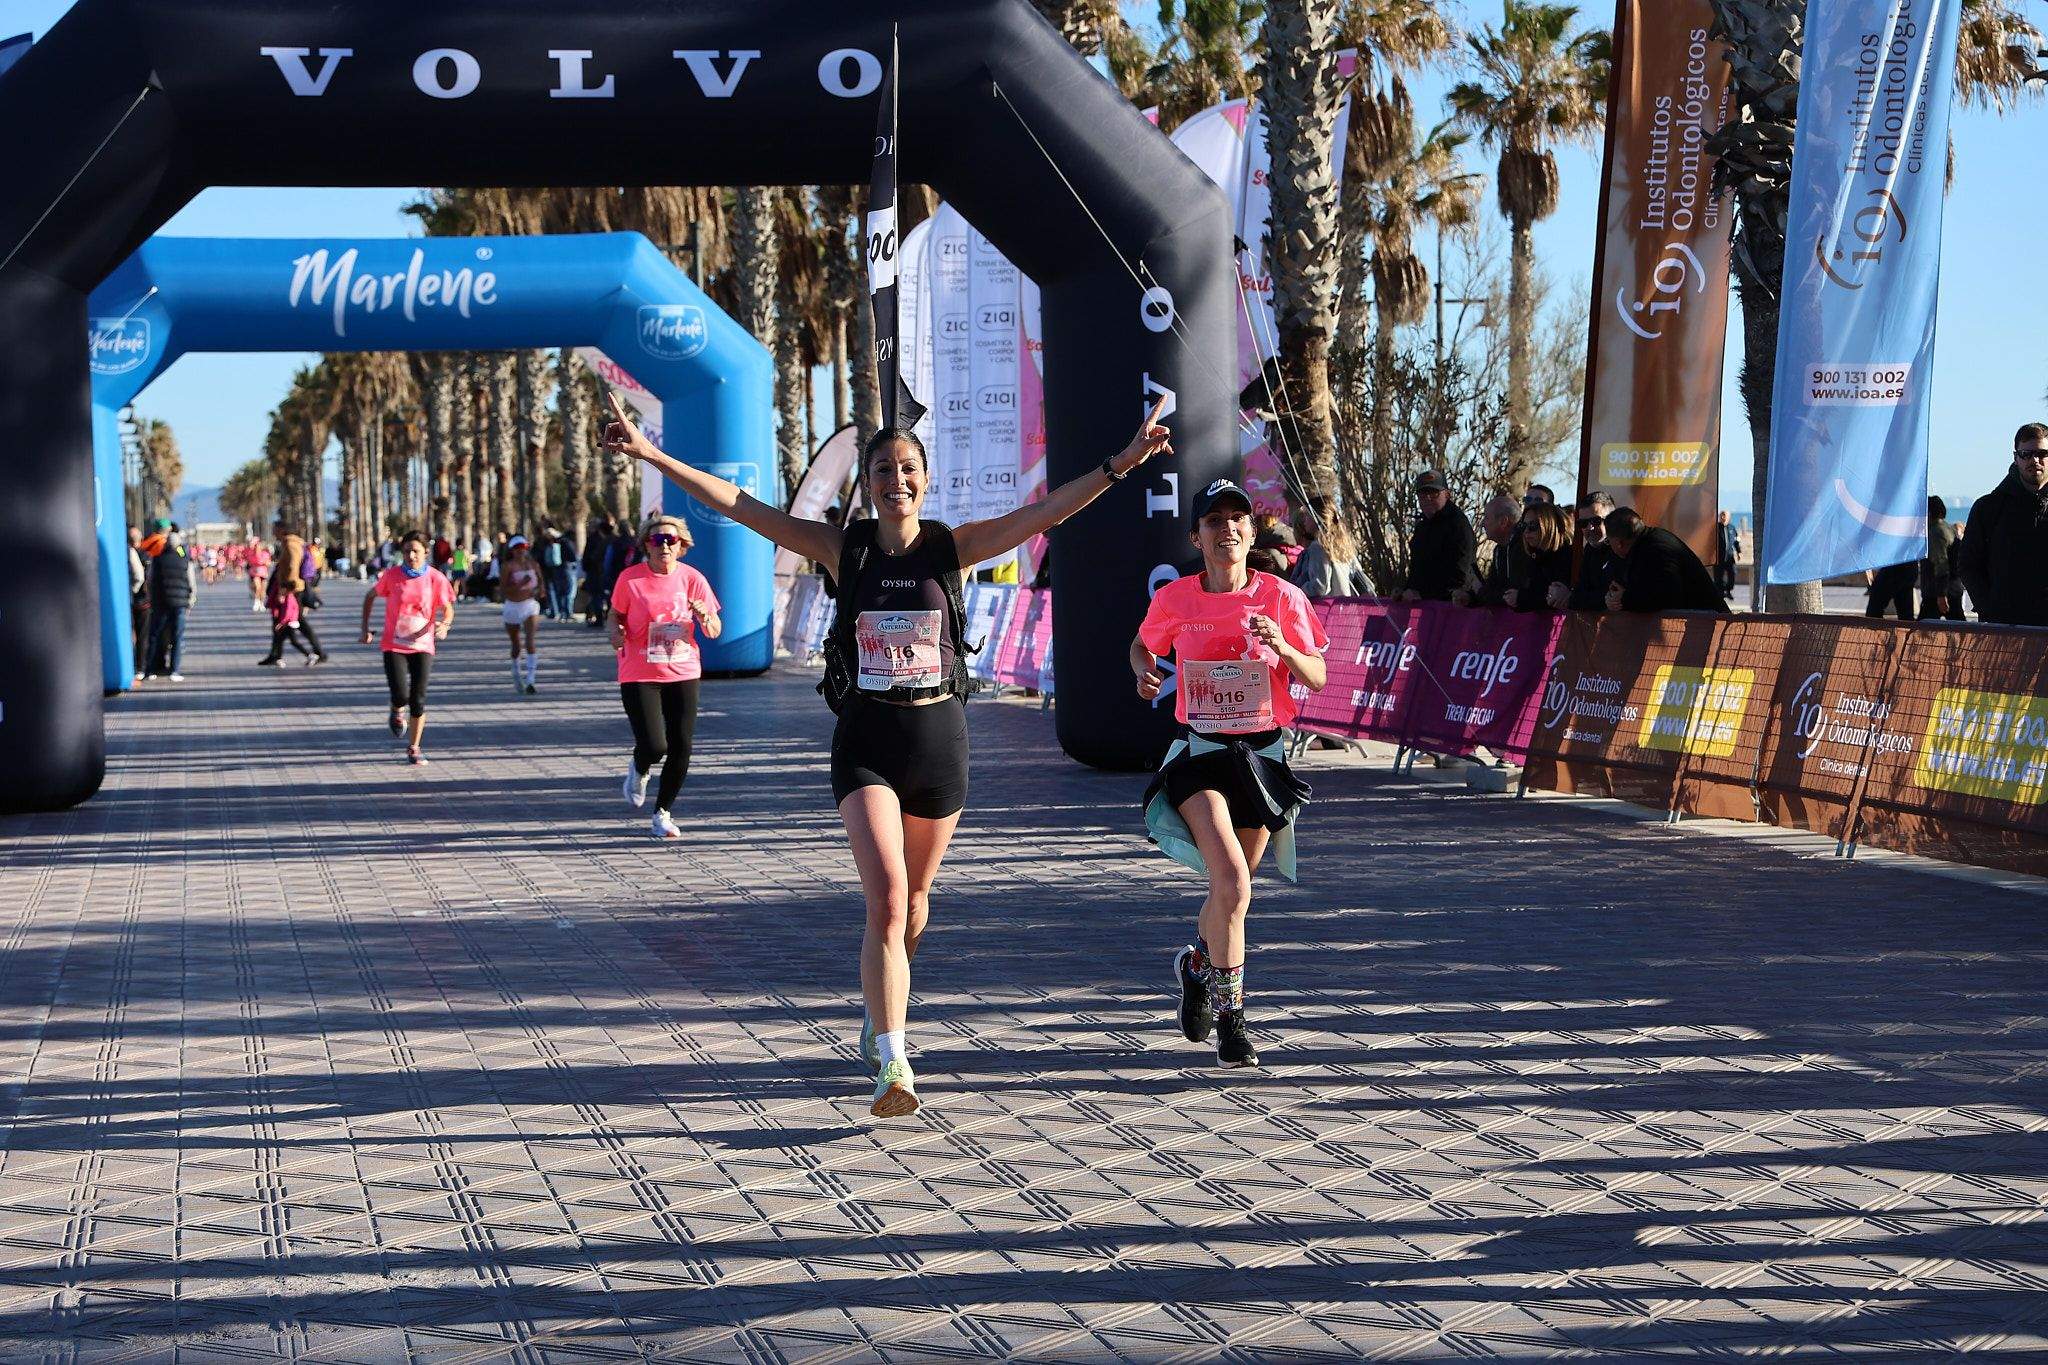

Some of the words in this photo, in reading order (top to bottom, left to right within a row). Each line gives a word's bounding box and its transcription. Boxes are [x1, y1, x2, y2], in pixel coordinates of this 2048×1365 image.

[260, 47, 883, 99] VOLVO
[1844, 34, 1880, 175] Institutos
[1671, 28, 1710, 232] Odontológicos
[1907, 102, 1927, 174] Clínicas
[1640, 95, 1672, 231] Institutos
[289, 248, 498, 337] Marlene
[1813, 371, 1840, 384] 900
[1844, 371, 1867, 384] 131
[1872, 370, 1905, 384] 002
[1812, 384, 1904, 399] www.ioa.es
[1609, 450, 1640, 464] 900
[1643, 450, 1666, 464] 131
[1671, 450, 1700, 464] 002
[881, 579, 916, 588] OYSHO
[1181, 623, 1215, 632] OYSHO
[884, 645, 915, 660] 016
[1355, 627, 1416, 685] renfe
[1450, 636, 1518, 699] renfe
[1575, 671, 1622, 695] Institutos
[1213, 690, 1245, 704] 016
[1351, 689, 1369, 707] TREN
[1445, 703, 1465, 722] TREN
[1568, 695, 1639, 726] Odontológicos
